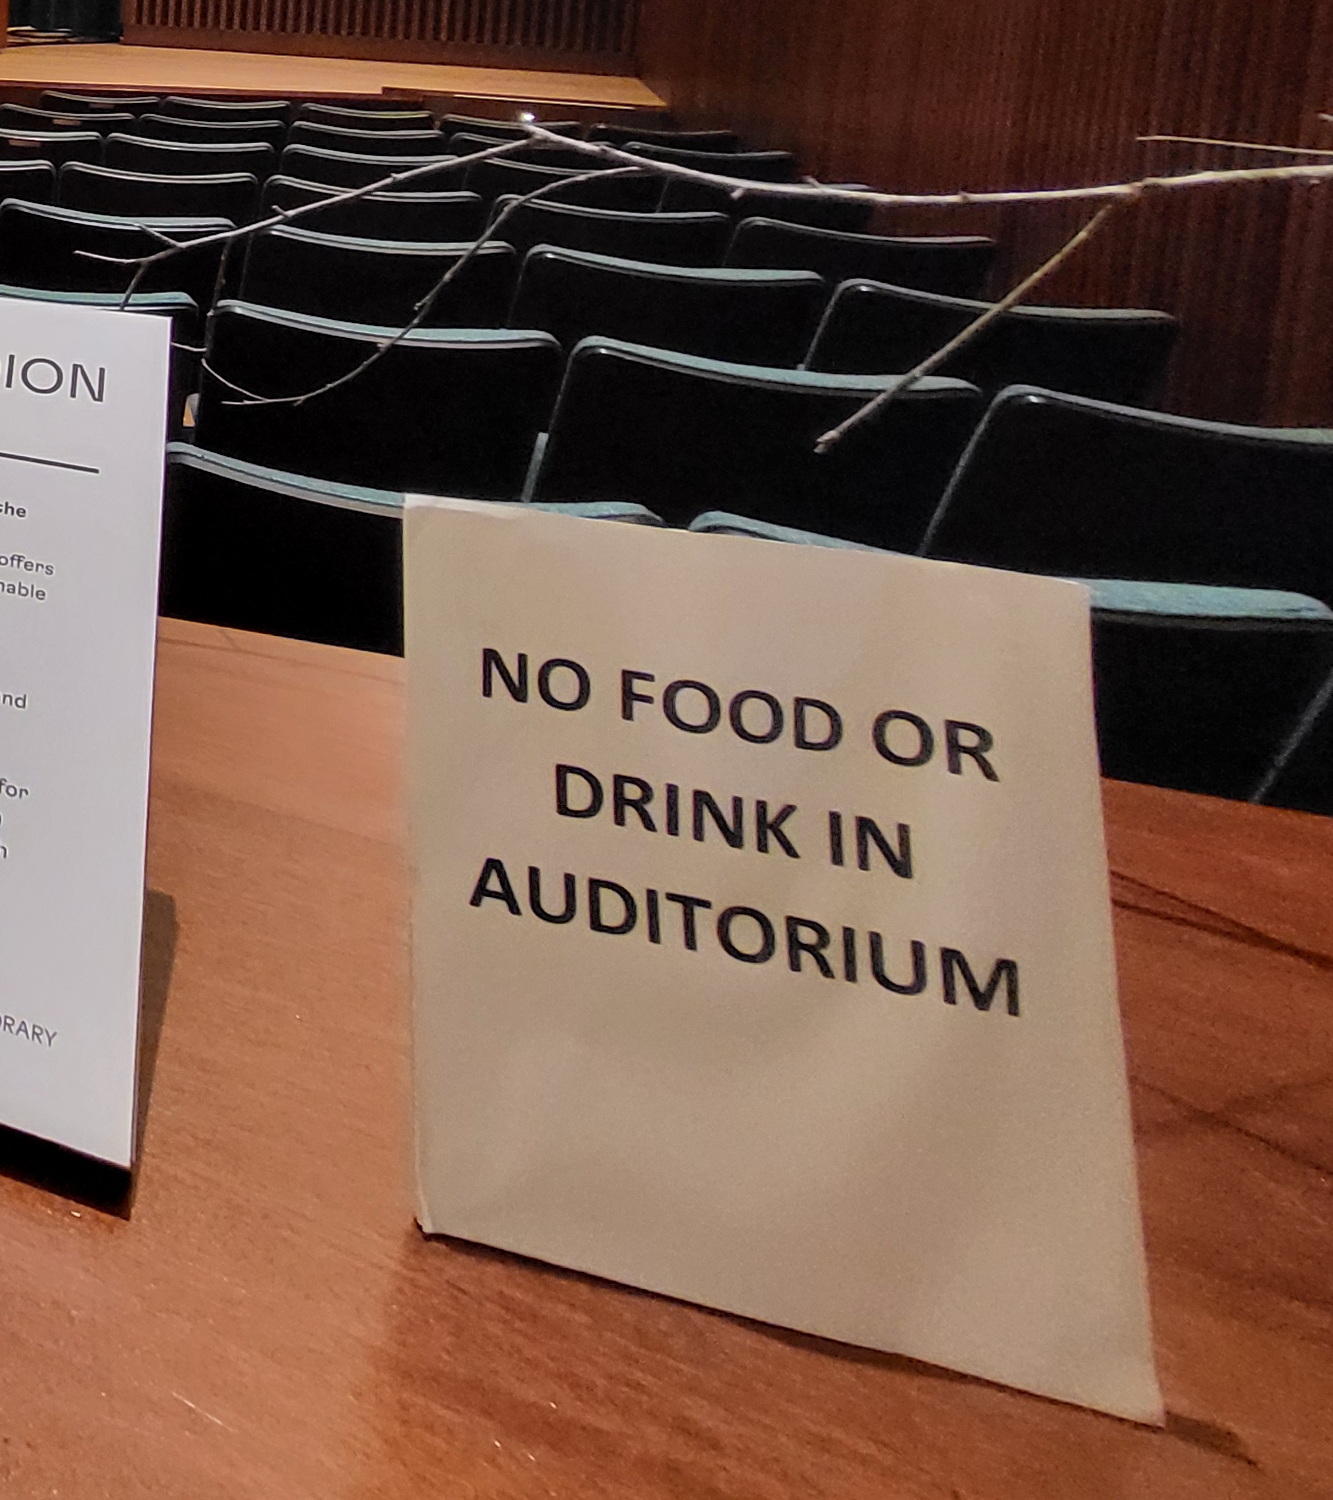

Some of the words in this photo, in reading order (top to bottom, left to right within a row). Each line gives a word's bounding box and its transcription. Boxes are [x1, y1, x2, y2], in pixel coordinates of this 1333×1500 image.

[482, 647, 591, 712] NO
[621, 669, 843, 752] FOOD
[871, 709, 1000, 783] OR
[554, 763, 801, 860] DRINK
[828, 811, 913, 879] IN
[469, 856, 1021, 1017] AUDITORIUM
